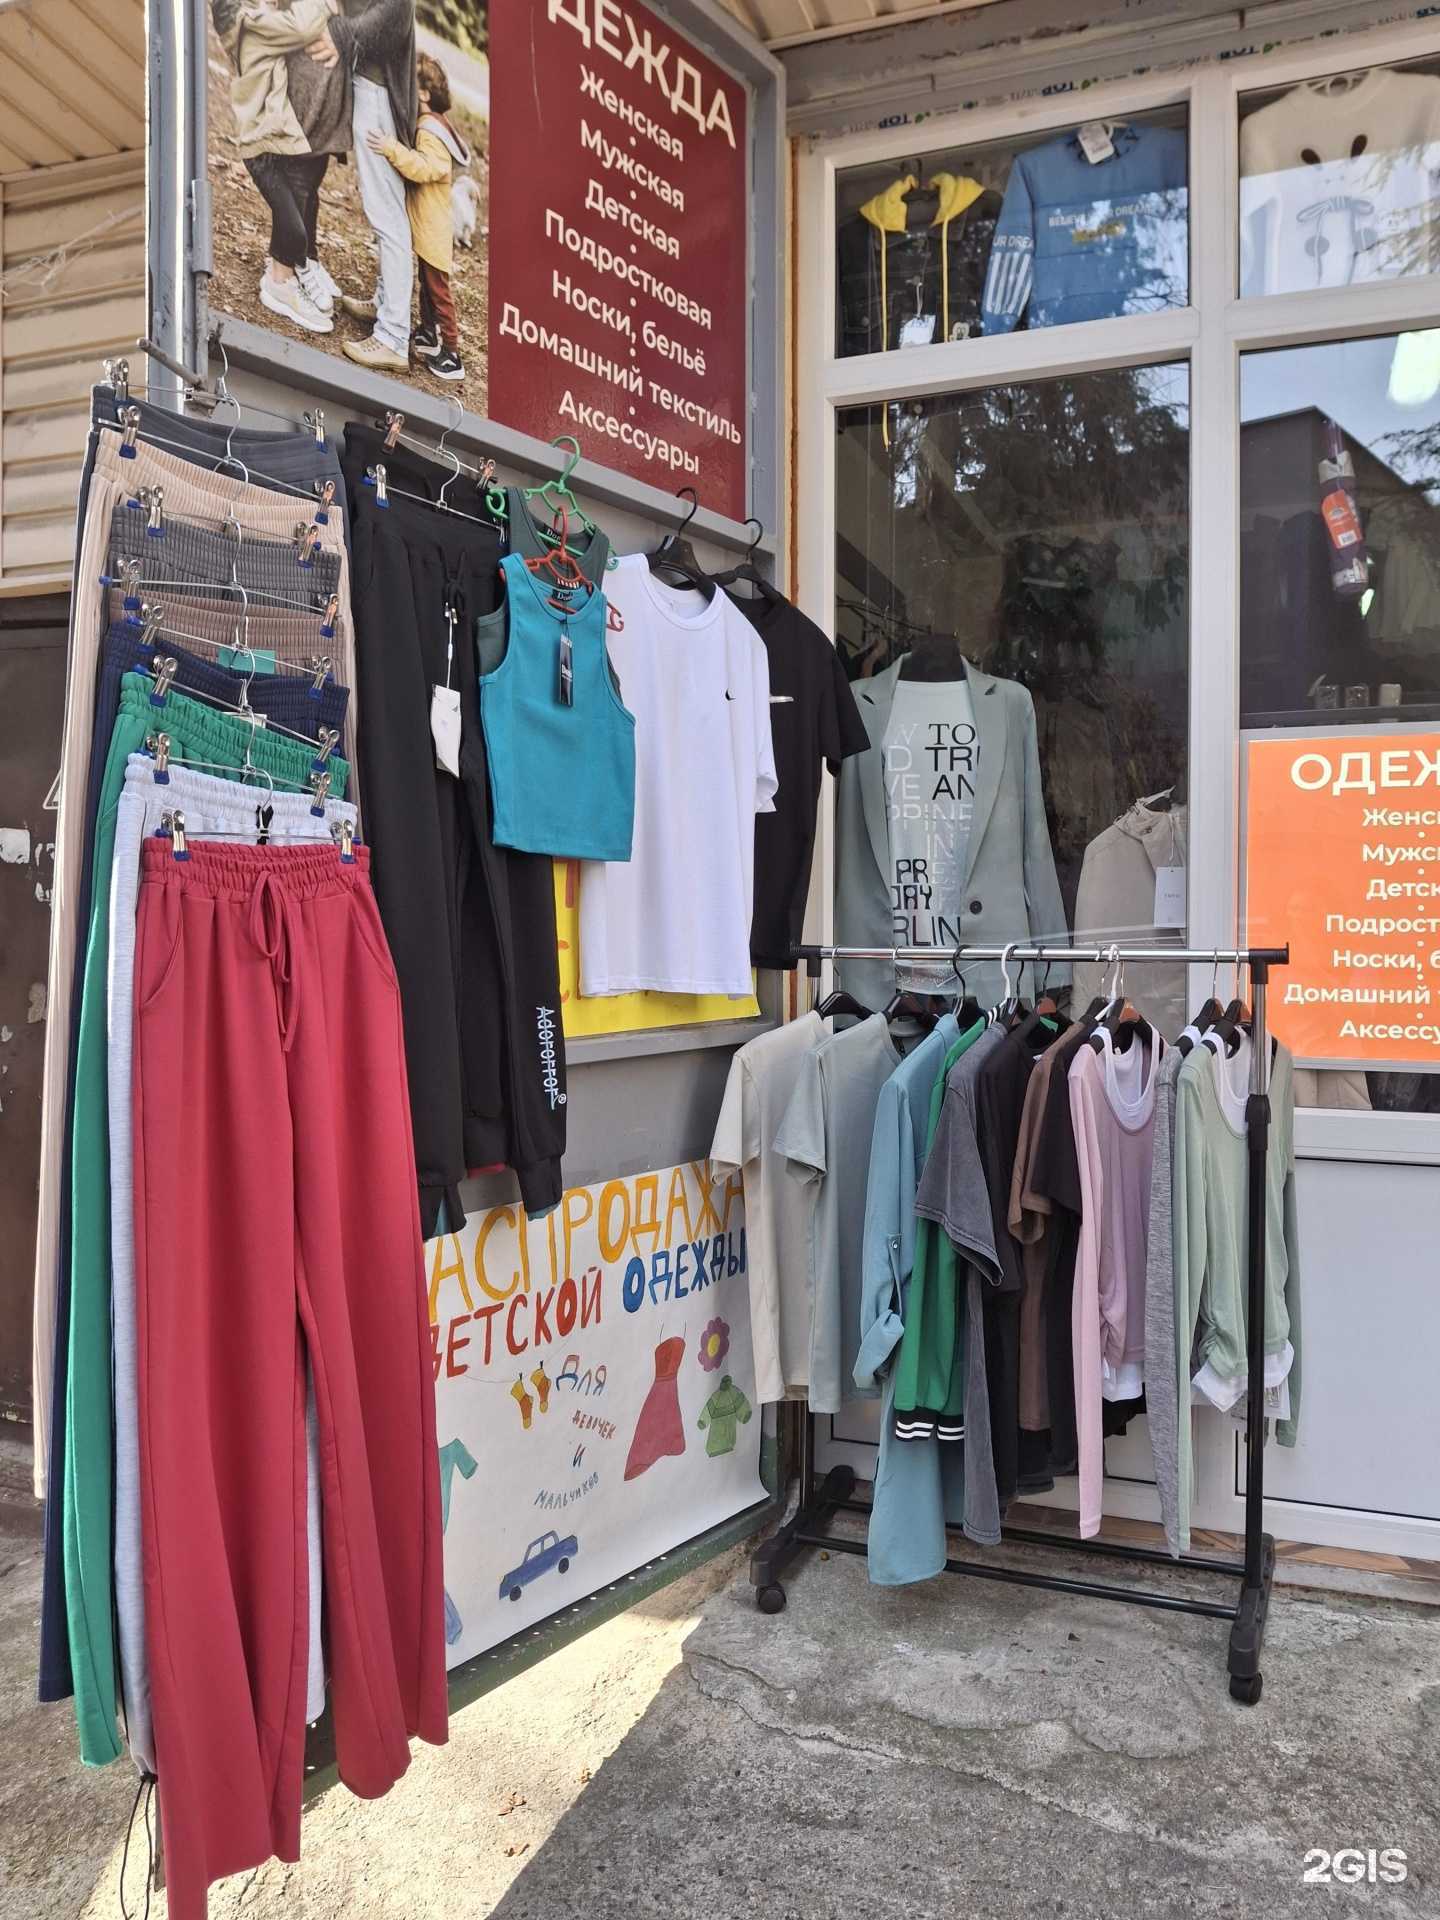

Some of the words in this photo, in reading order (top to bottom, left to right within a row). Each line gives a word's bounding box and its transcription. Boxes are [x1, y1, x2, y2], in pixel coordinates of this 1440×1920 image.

[580, 63, 683, 161] Женская
[581, 119, 684, 212] Мужская
[585, 178, 680, 259] Детская
[546, 208, 711, 330] Подростковая
[552, 269, 636, 344] Носки,
[642, 321, 706, 376] бельё
[499, 302, 643, 397] Домашний
[649, 381, 742, 444] текстиль
[558, 390, 699, 475] Аксессуары
[928, 723, 976, 745] TO
[1326, 915, 1440, 936] Подрост
[1333, 950, 1422, 972] Носки,
[1284, 984, 1430, 1004] Домашний
[622, 1227, 746, 1313] ОДЕЖДЫ
